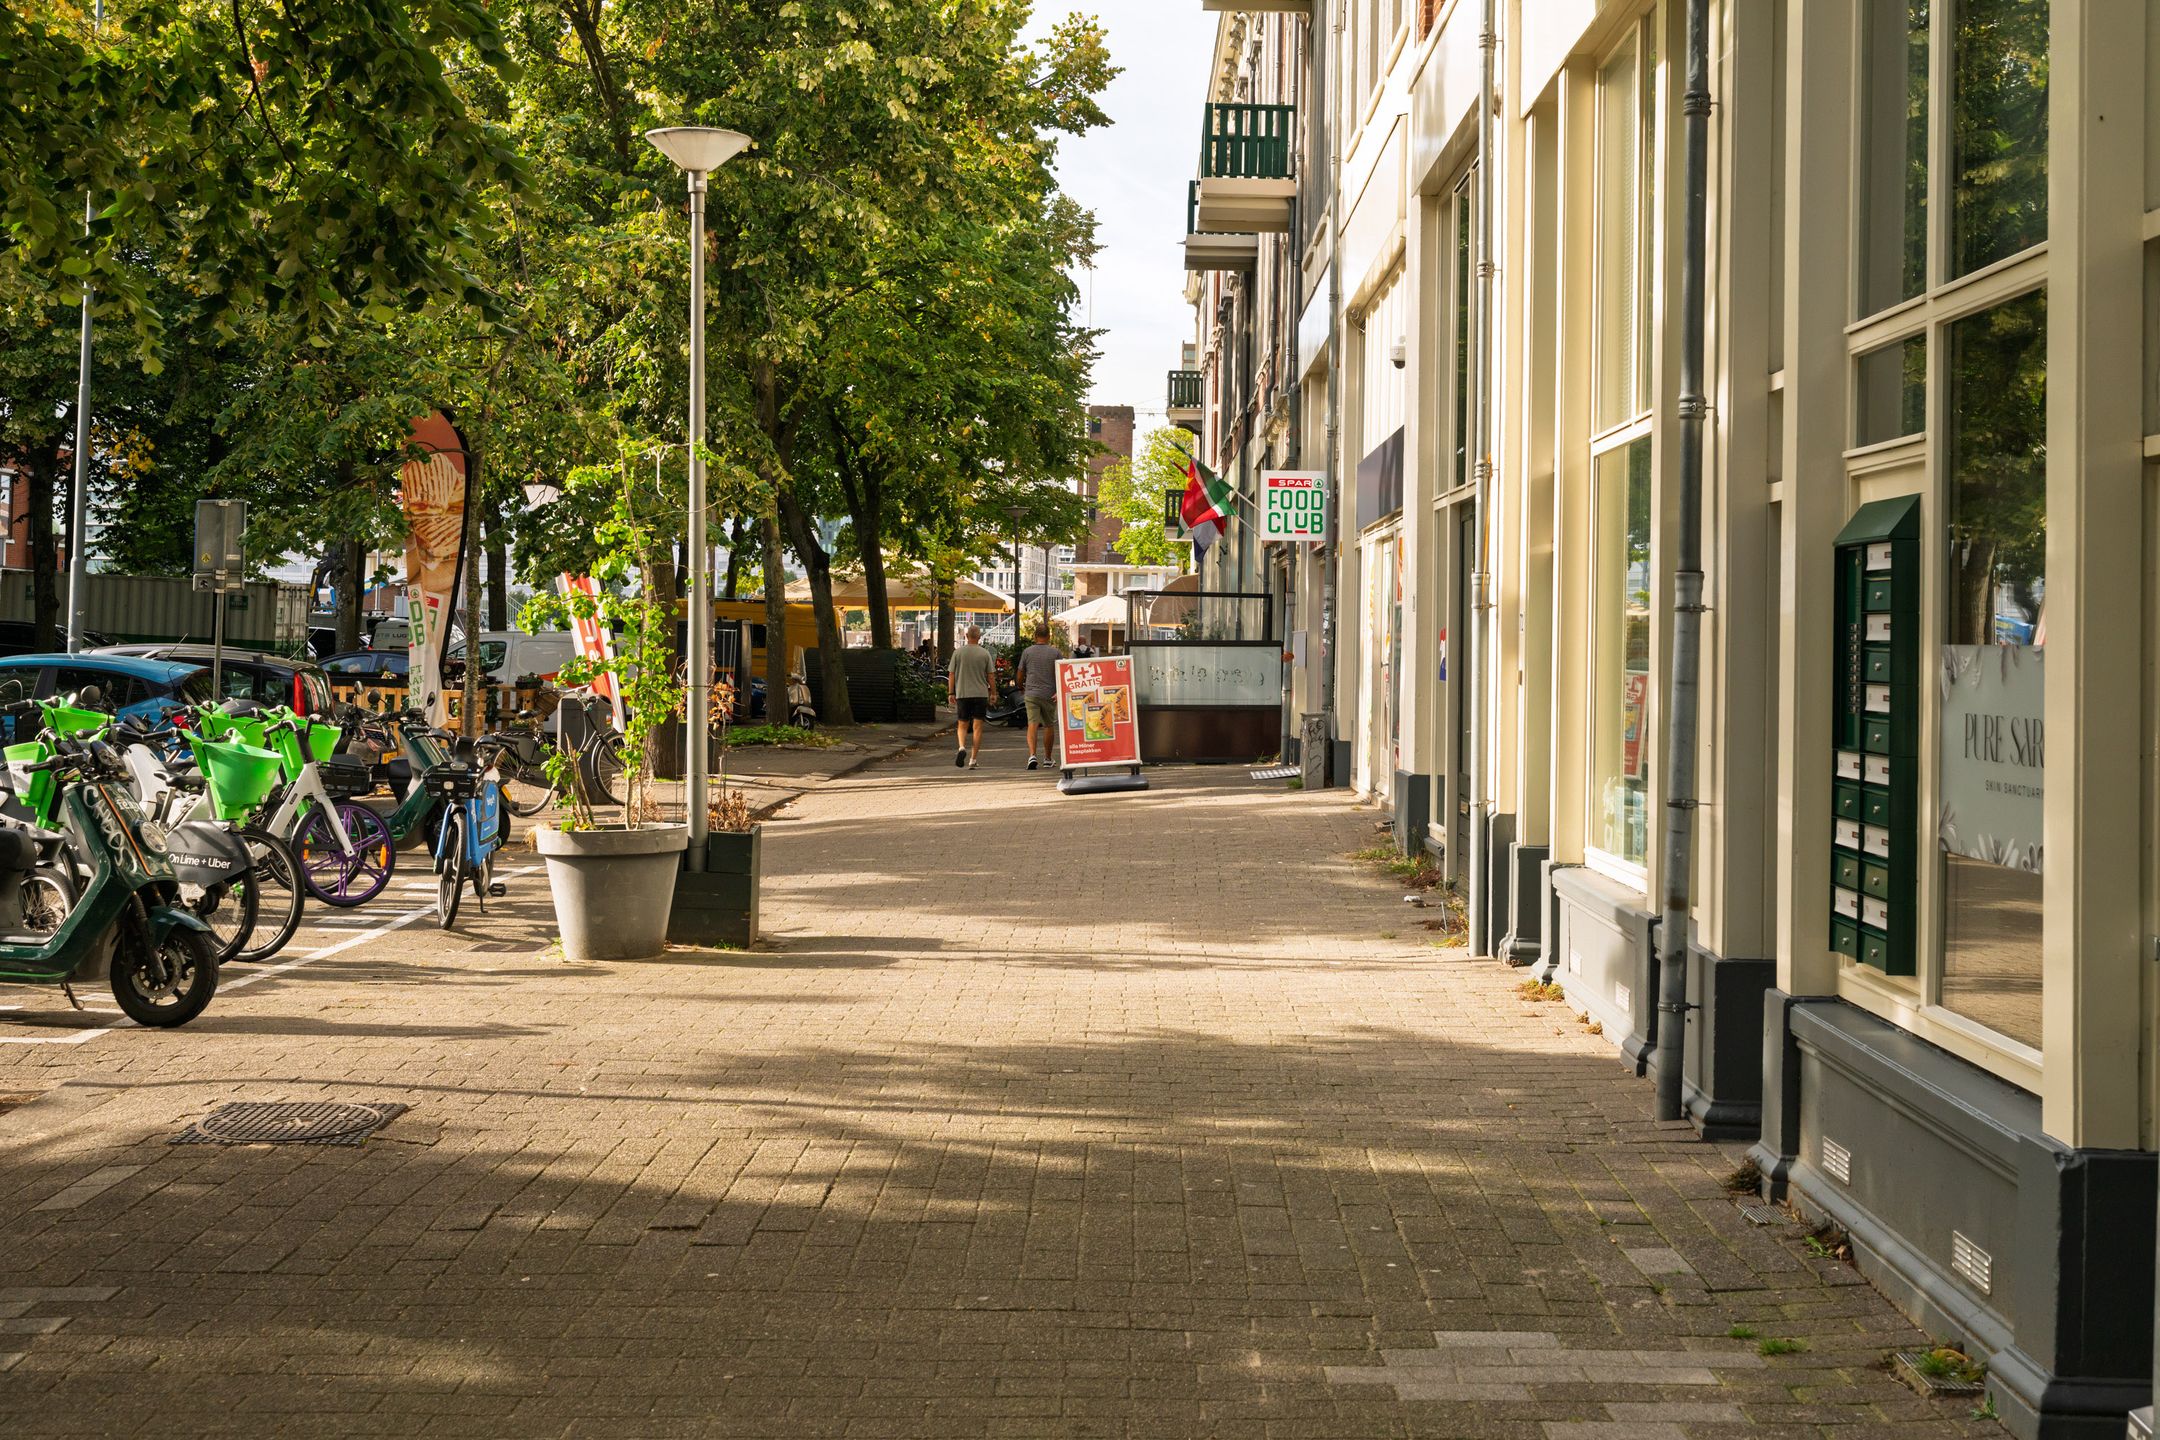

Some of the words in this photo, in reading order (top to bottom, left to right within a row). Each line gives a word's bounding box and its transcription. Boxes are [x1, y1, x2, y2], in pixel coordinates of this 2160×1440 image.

[1268, 489, 1324, 511] FOOD
[1267, 511, 1324, 534] CLUB
[1065, 662, 1102, 682] 1+1
[1067, 677, 1103, 690] GRATIS
[1964, 713, 2005, 764] PURE
[1985, 779, 2001, 792] SKIN
[168, 853, 180, 864] On
[180, 854, 200, 866] Lime
[208, 857, 232, 869] Uber
